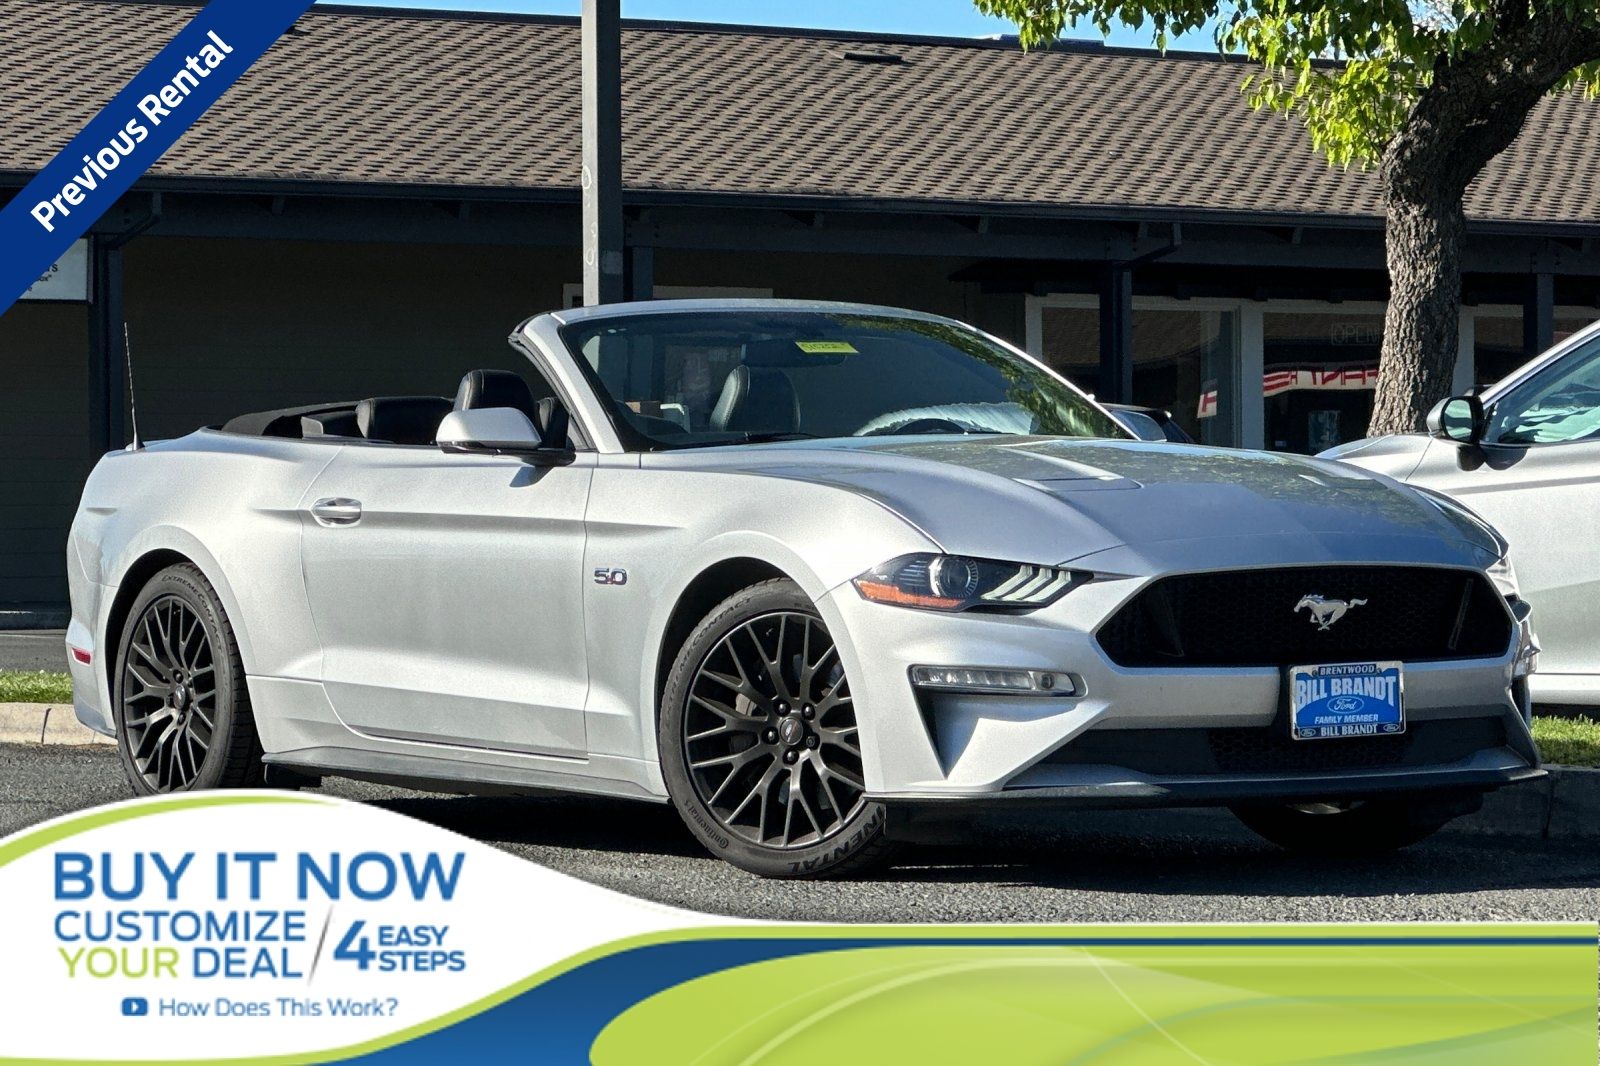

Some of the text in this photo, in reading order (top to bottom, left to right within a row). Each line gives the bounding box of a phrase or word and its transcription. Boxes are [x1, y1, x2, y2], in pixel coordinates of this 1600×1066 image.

[594, 568, 627, 585] 5.0
[1320, 665, 1375, 676] BRENTWOOD
[1295, 676, 1397, 714] BILL BRANDT
[1334, 698, 1357, 711] Ford
[1314, 713, 1379, 725] FAMILY MEMBER
[1320, 727, 1339, 737] BILL
[1341, 723, 1378, 735] BRANDT
[688, 806, 730, 849] Continental
